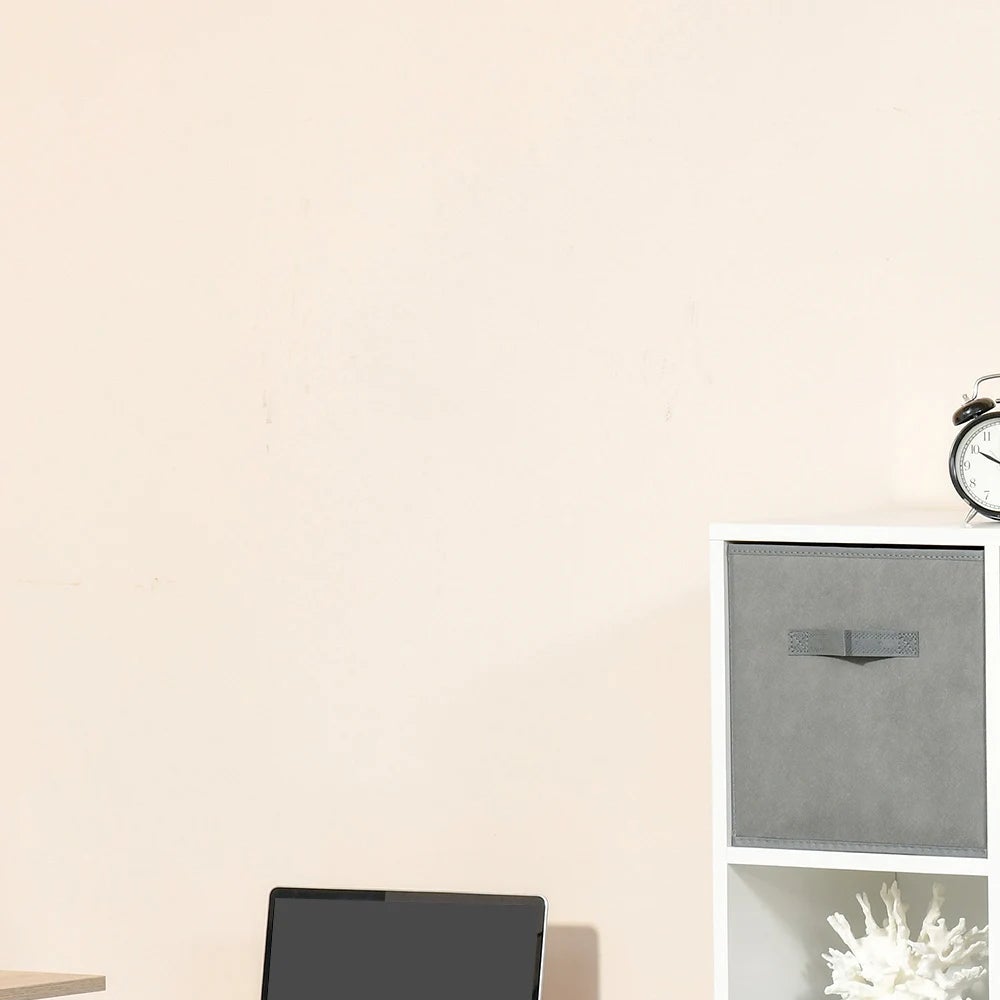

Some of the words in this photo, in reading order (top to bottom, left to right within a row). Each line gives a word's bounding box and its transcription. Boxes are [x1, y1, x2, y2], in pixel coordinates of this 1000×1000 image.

[983, 431, 991, 442] 11
[970, 444, 980, 455] 10
[964, 460, 971, 471] 9
[969, 478, 977, 488] 8
[984, 490, 990, 501] 7
